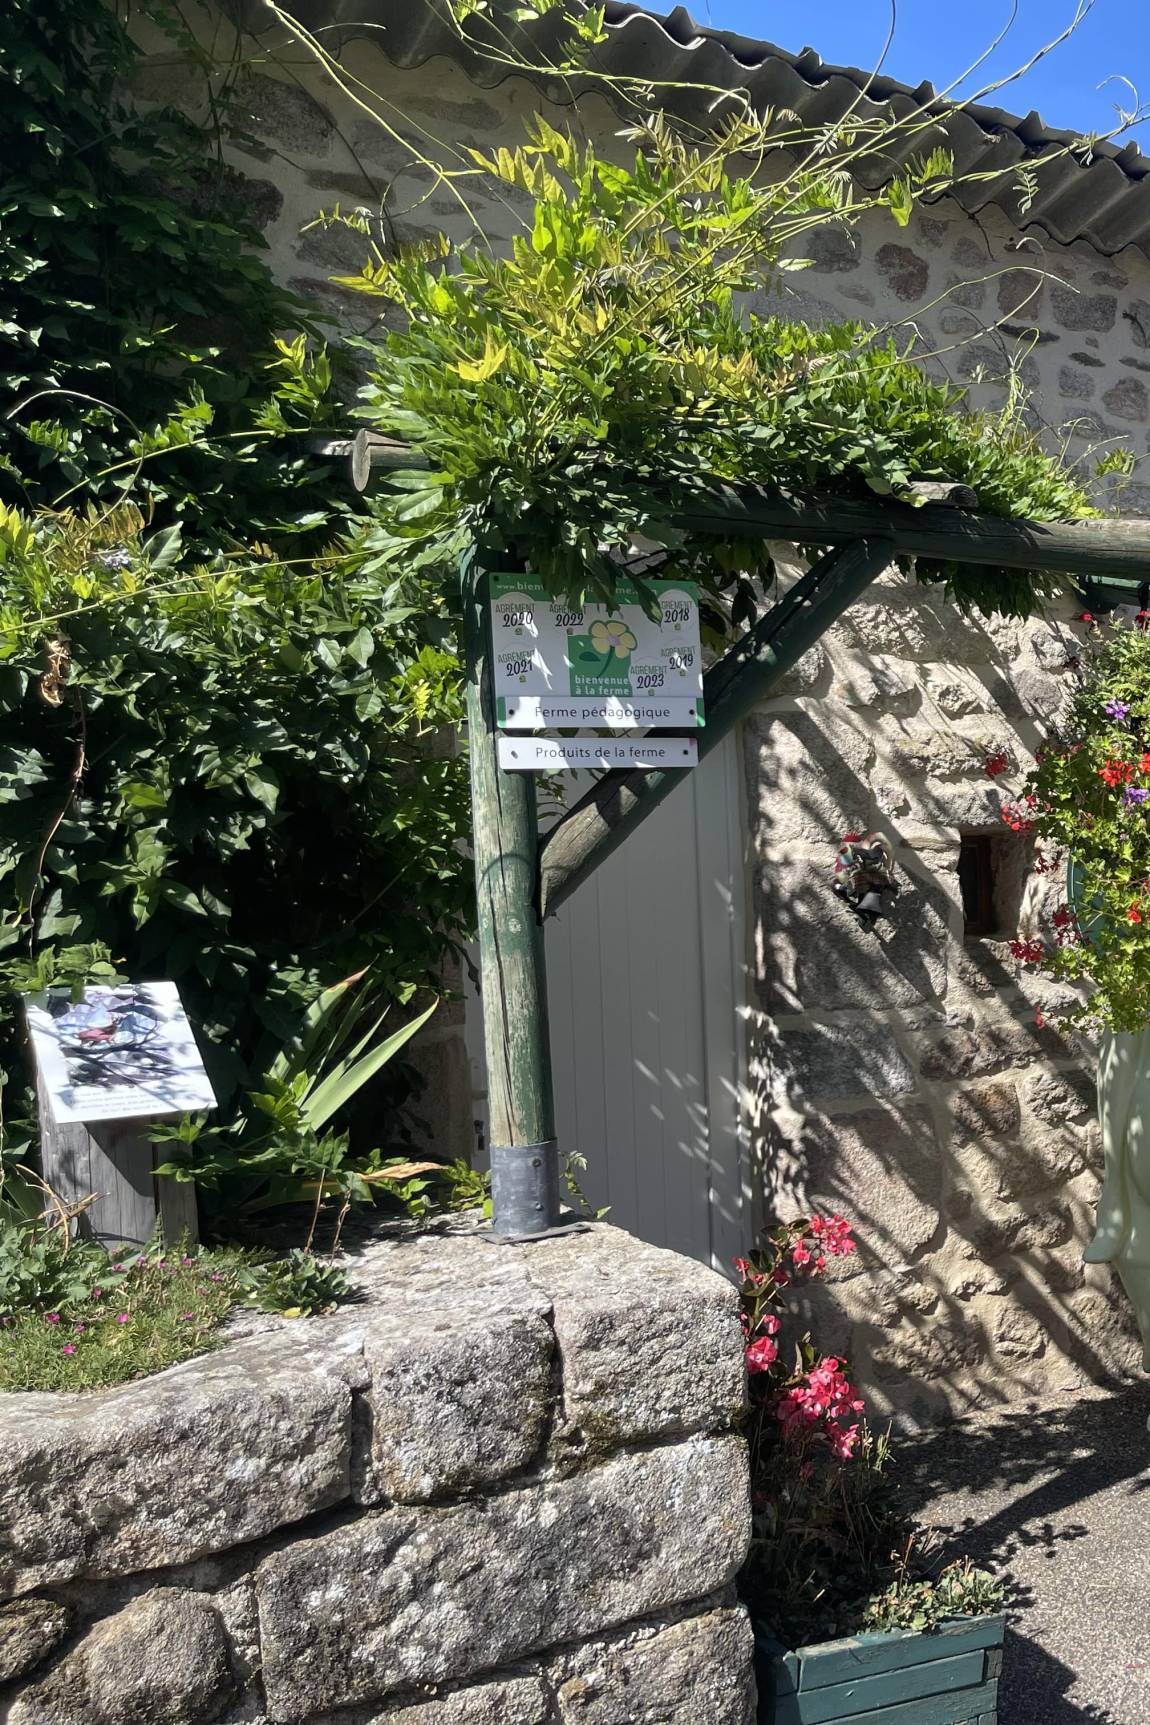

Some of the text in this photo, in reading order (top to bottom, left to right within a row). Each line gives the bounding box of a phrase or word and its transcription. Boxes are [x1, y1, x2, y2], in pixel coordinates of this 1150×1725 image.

[503, 610, 534, 627] 2020
[555, 613, 584, 627] 2022
[664, 608, 690, 624] 2018
[506, 659, 534, 677] 2021
[669, 654, 694, 669] 2019
[575, 675, 629, 686] bienvenue
[636, 674, 665, 689] 2023
[575, 685, 630, 696] à la ferme
[535, 705, 671, 721] Ferme pédagogique
[535, 747, 666, 758] Produits de la ferme
